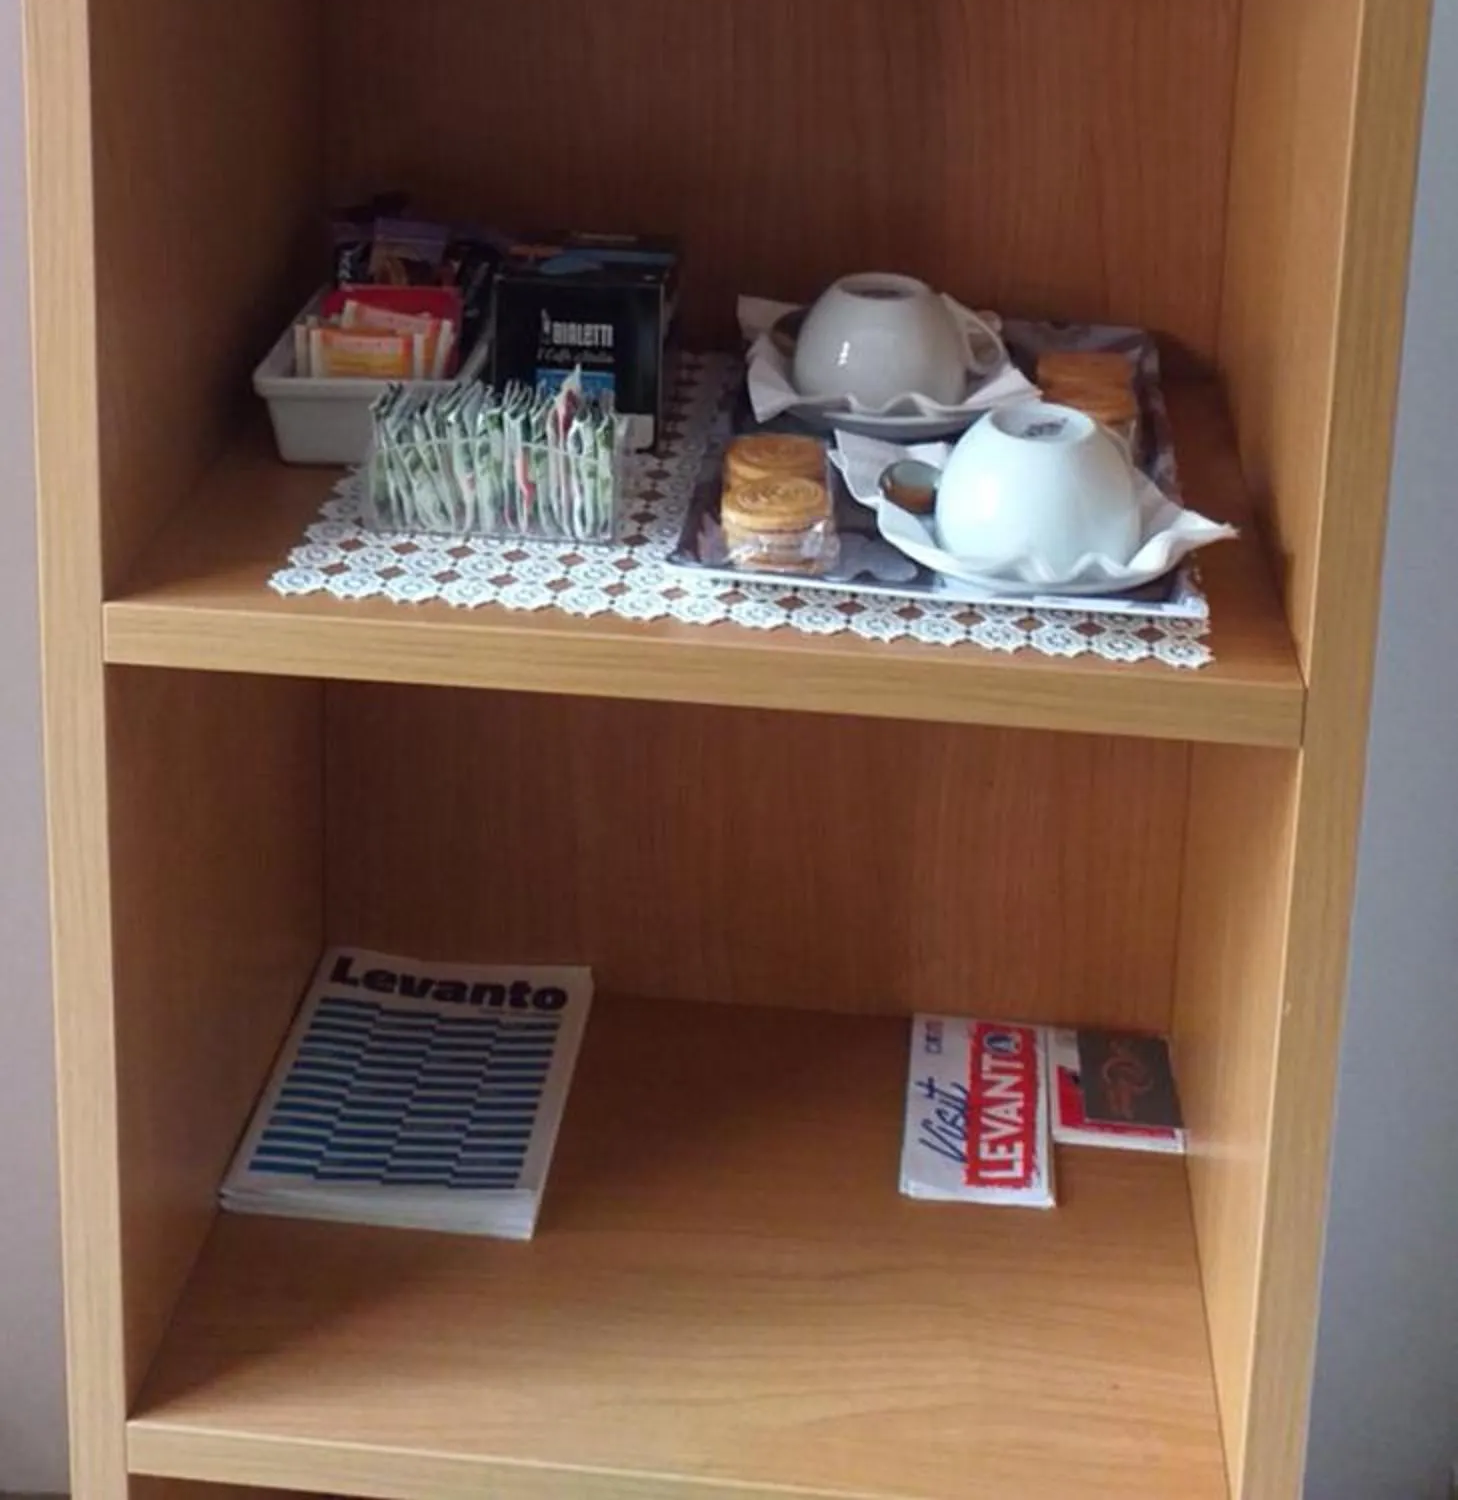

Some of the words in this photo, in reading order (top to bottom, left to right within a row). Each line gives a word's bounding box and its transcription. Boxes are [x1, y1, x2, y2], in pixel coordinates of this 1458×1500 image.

[552, 321, 614, 348] BIALETTI
[330, 955, 569, 1012] Levanto
[914, 1076, 969, 1164] Visit
[978, 1030, 1025, 1179] LEVANTO
